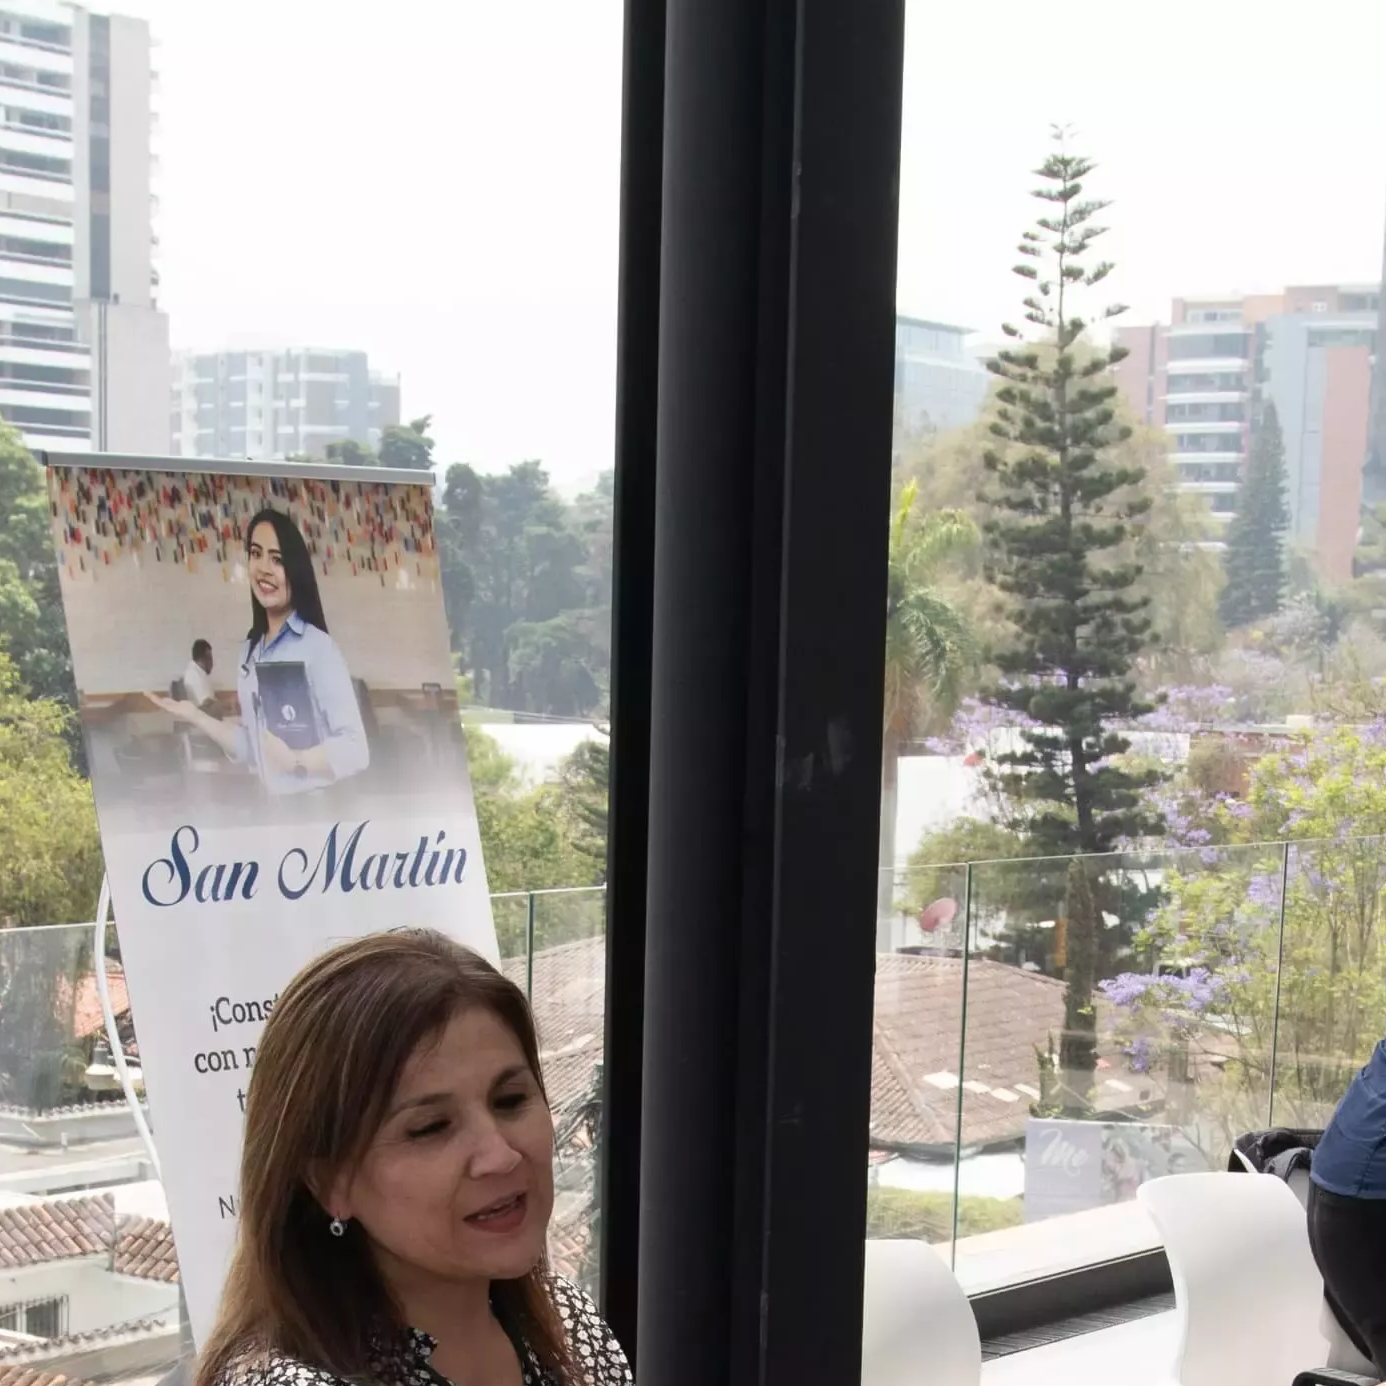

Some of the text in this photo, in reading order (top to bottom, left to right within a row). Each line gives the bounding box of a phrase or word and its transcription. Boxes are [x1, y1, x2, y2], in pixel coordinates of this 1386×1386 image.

[142, 820, 467, 906] San Martín
[194, 1049, 239, 1074] con
